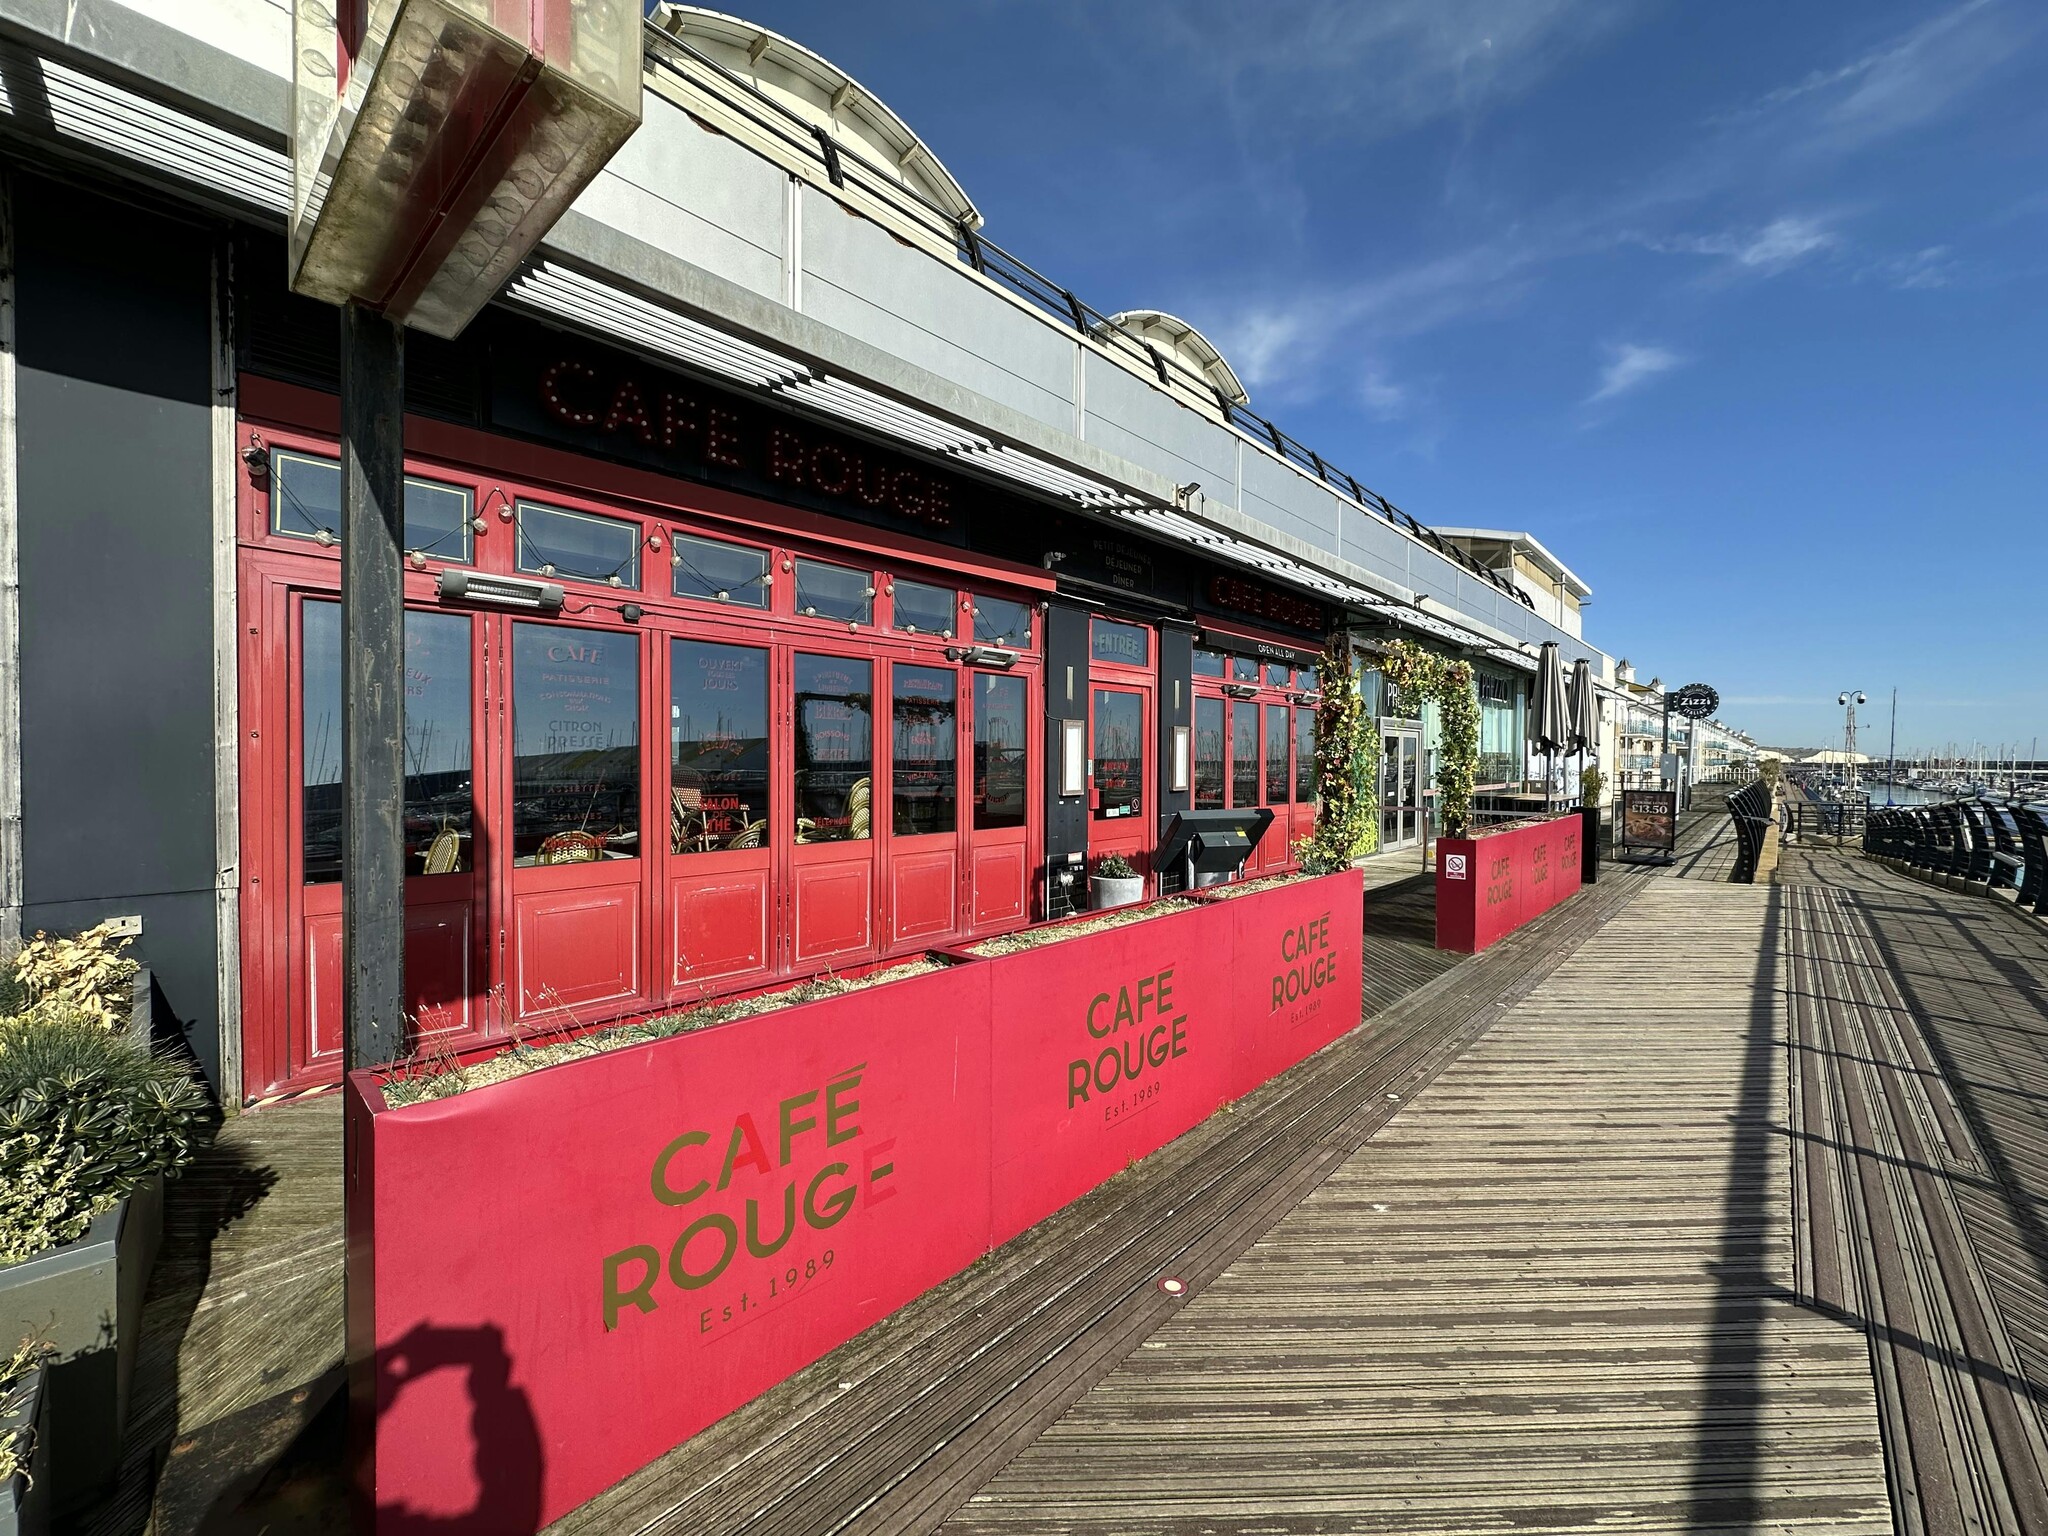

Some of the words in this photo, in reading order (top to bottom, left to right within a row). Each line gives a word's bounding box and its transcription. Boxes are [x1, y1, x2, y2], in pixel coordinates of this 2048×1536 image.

[540, 359, 745, 469] CAFE
[767, 425, 954, 528] ROUGE
[1257, 643, 1275, 655] OPEN
[1275, 648, 1285, 658] ALL
[1285, 650, 1297, 660] DAY
[703, 679, 739, 691] JOURS
[1683, 707, 1708, 716] ITALIAN
[549, 720, 602, 733] CITRON
[701, 797, 739, 811] SALON
[713, 811, 726, 820] DE
[1632, 804, 1668, 814] £13.50
[1487, 878, 1512, 907] ROUGE
[1282, 910, 1331, 962] CAFÉ
[1272, 951, 1337, 1012] ROUGE
[1290, 1010, 1304, 1023] Est.
[1305, 998, 1322, 1016] 1989
[1068, 1014, 1188, 1110] ROUGE
[1105, 1101, 1129, 1122] Est.
[1133, 1081, 1160, 1106] 1989
[650, 1061, 868, 1207] CAFÉ
[602, 1136, 898, 1333] ROUGE
[700, 1292, 758, 1335] Est.
[768, 1249, 835, 1299] 1989
